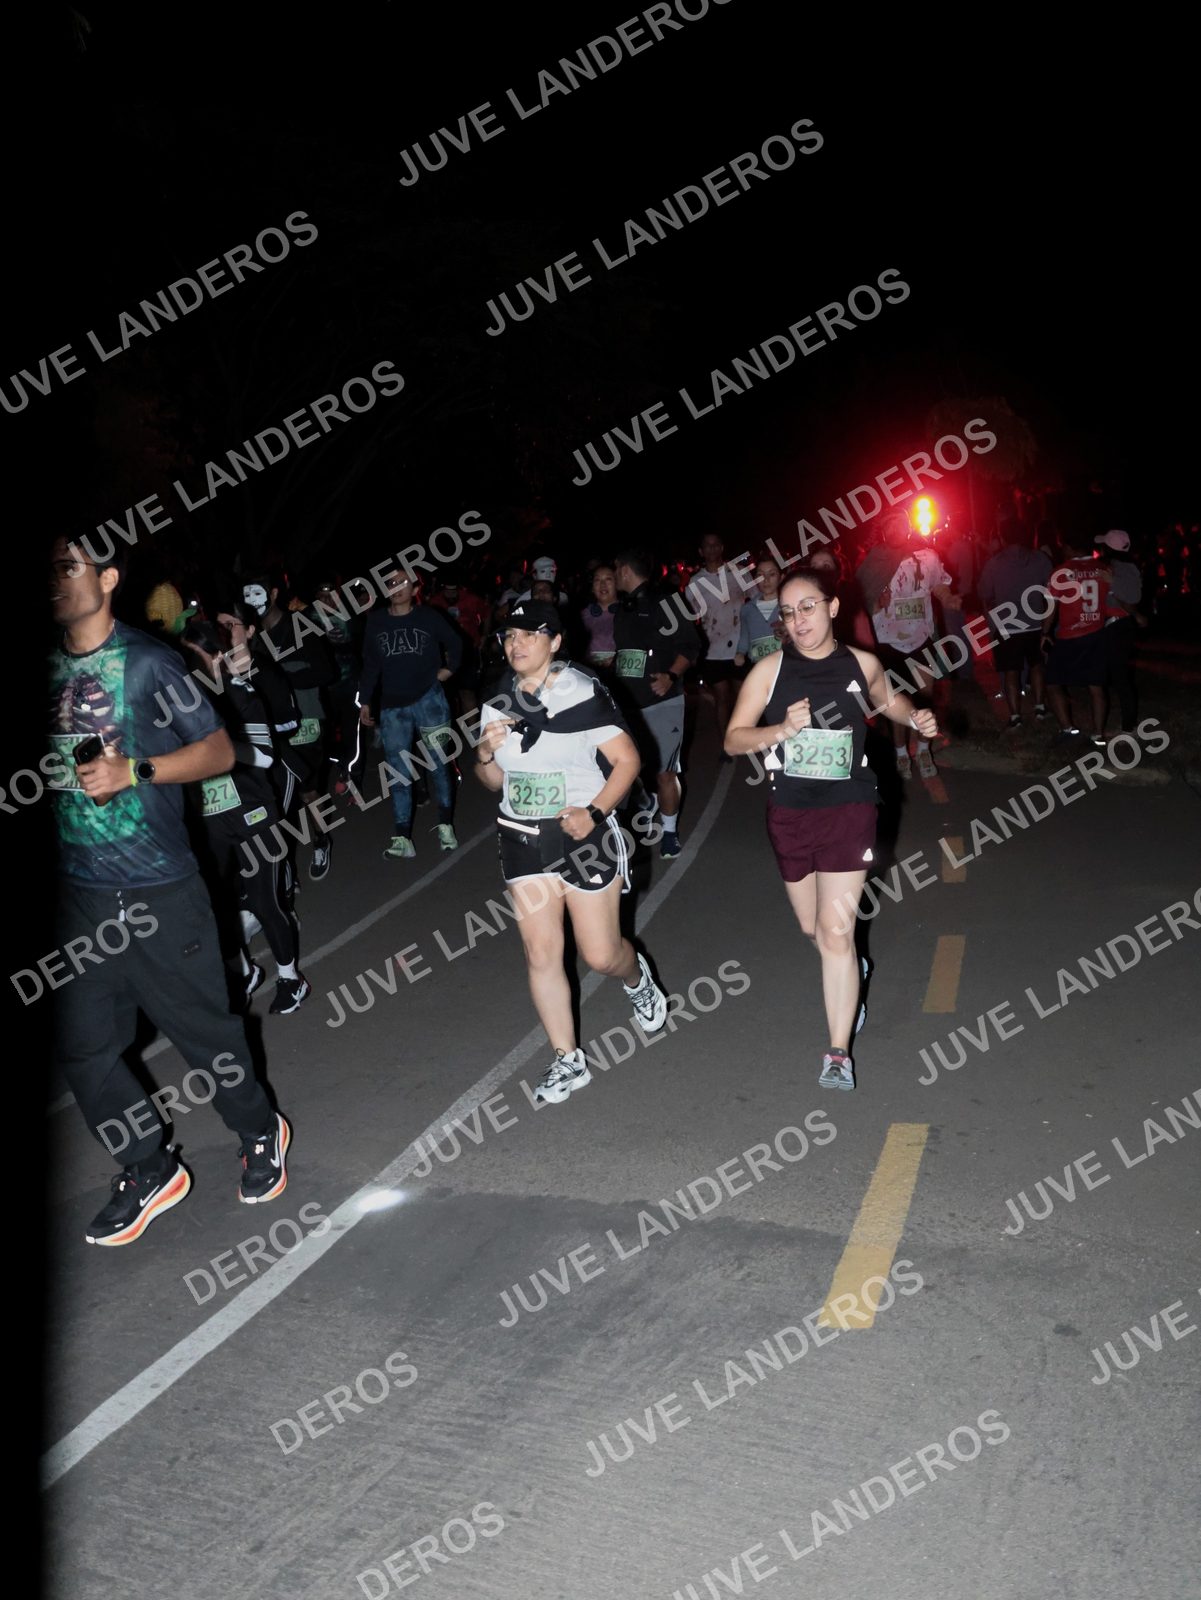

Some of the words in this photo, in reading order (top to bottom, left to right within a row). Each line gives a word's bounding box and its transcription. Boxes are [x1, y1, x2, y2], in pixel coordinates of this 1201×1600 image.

[1075, 579, 1099, 612] 9
[792, 743, 847, 767] 3253
[513, 784, 560, 806] 3252
